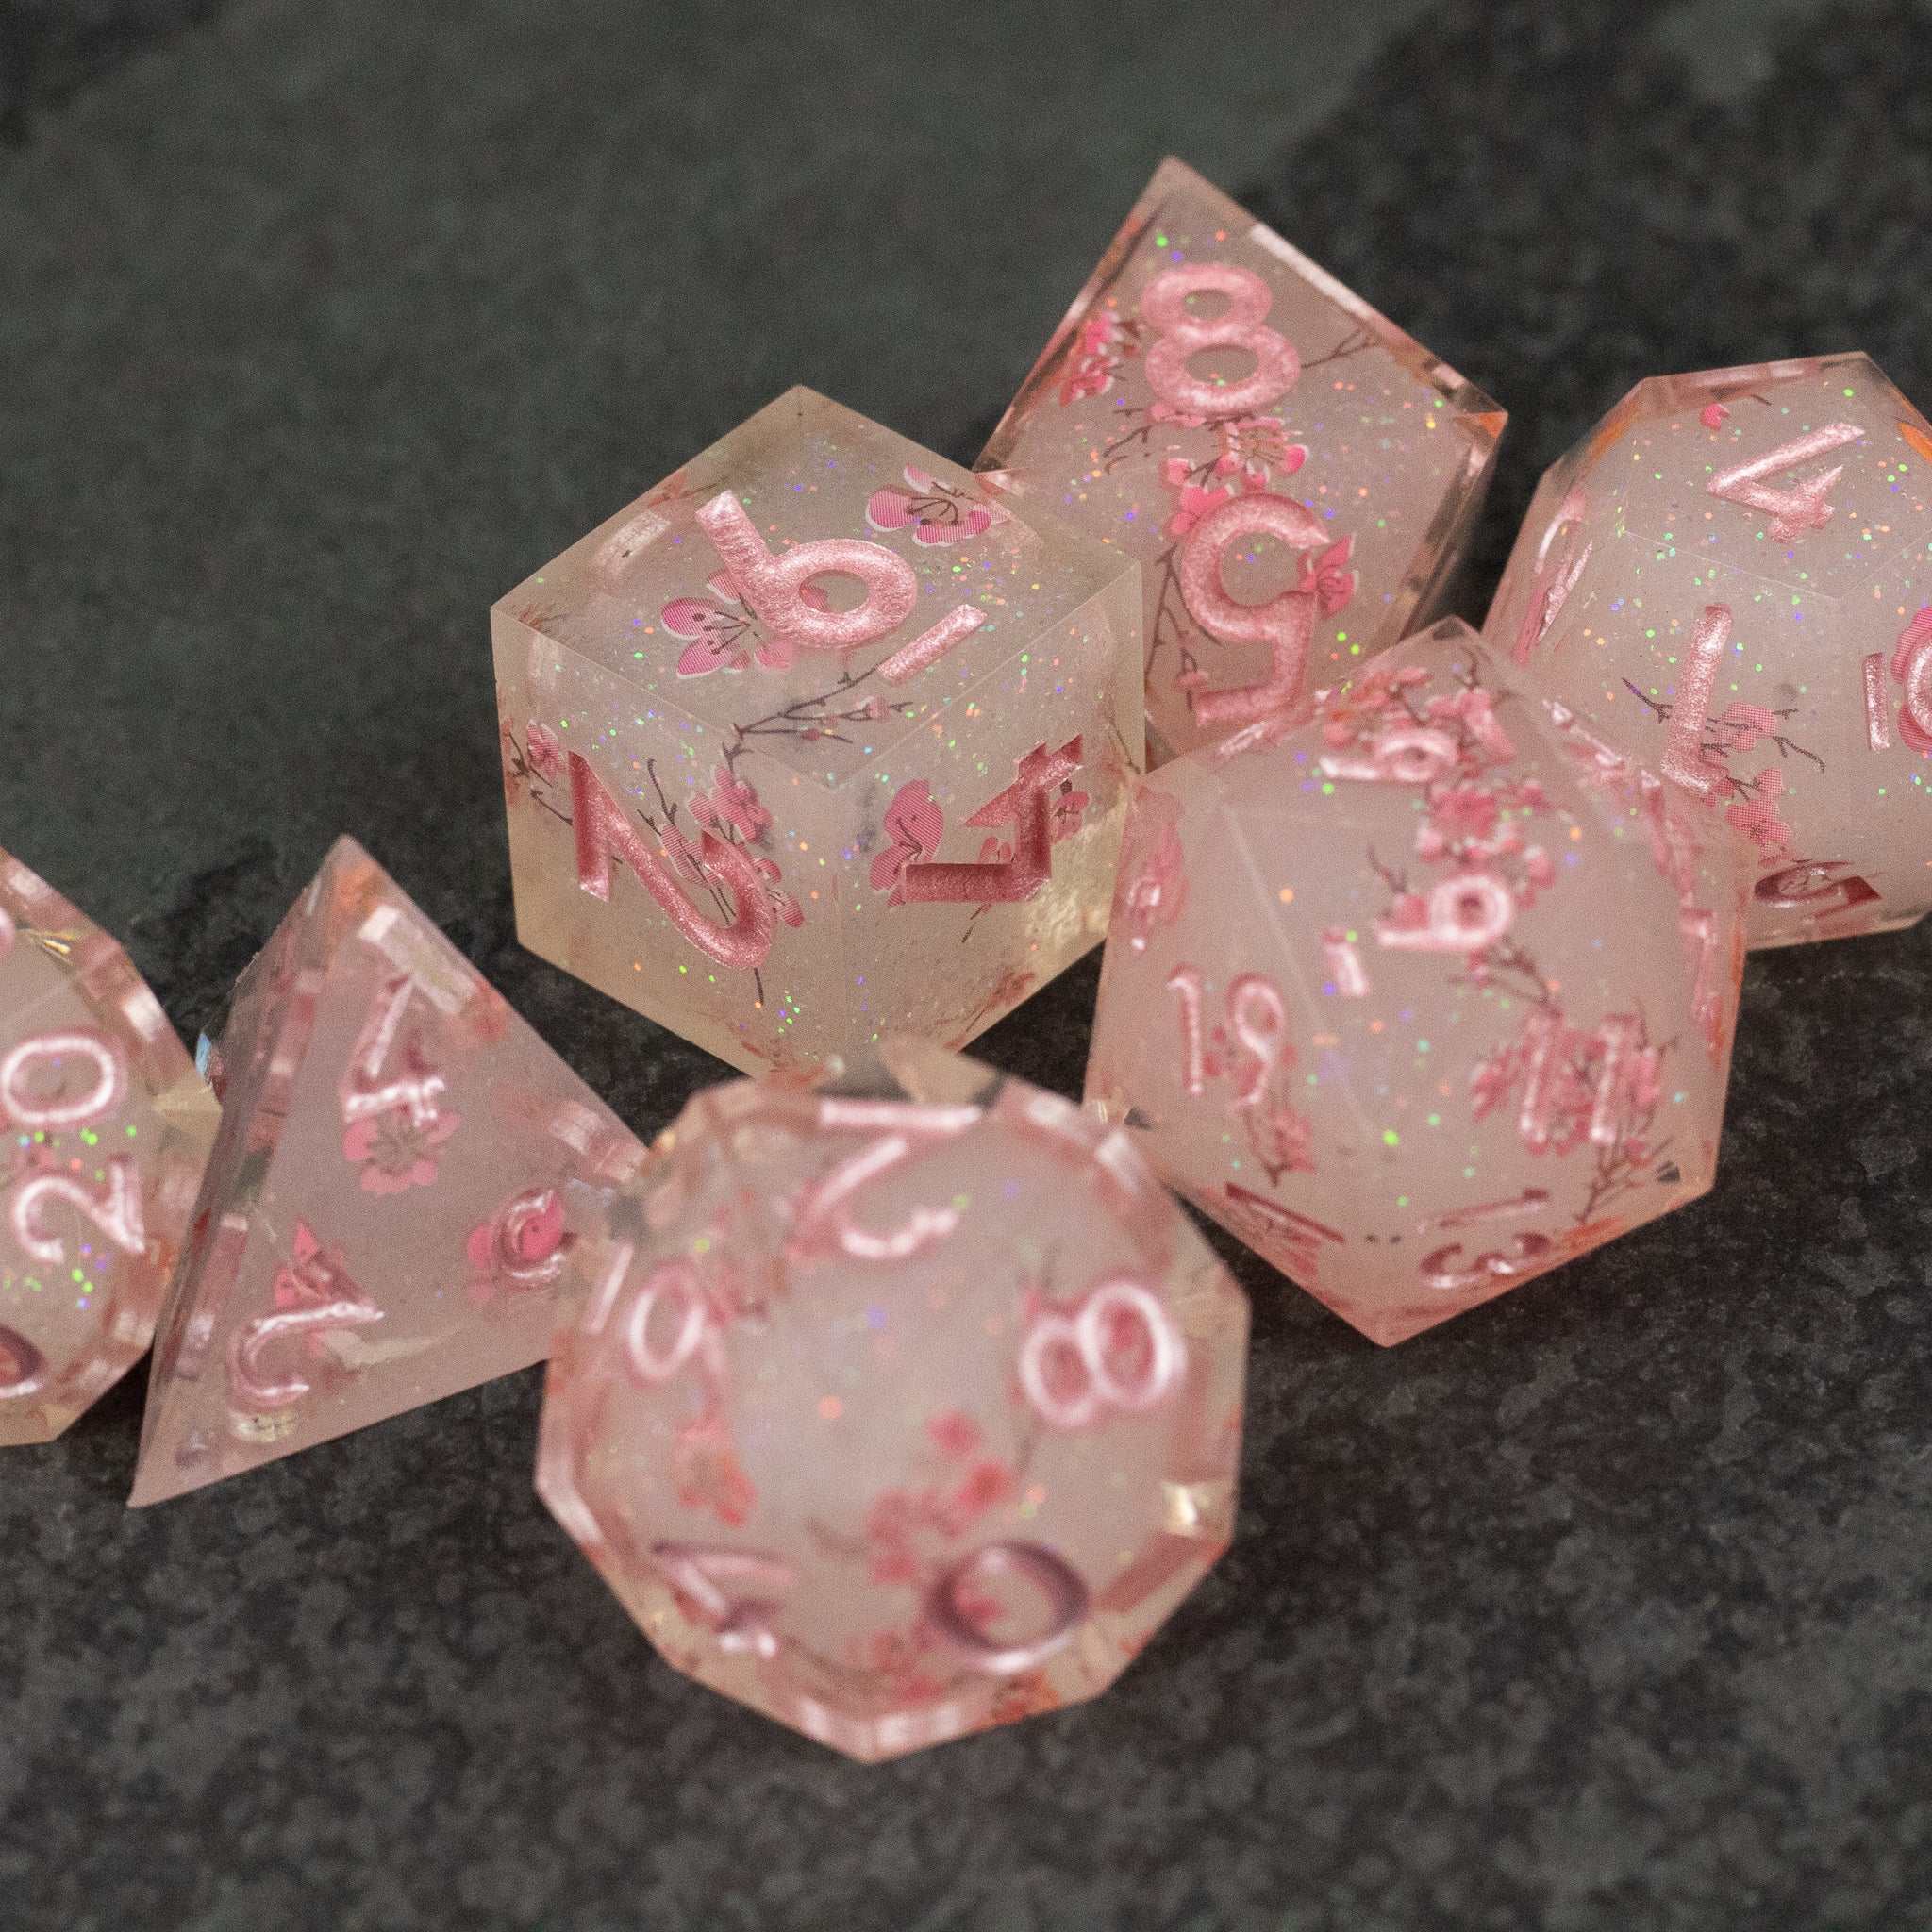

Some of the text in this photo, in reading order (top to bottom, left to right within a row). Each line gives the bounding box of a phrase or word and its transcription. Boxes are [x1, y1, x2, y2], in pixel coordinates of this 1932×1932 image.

[1140, 263, 1301, 417] 8
[1707, 421, 1866, 545] 4
[695, 490, 919, 648] 6
[1181, 493, 1331, 726] 5
[567, 750, 775, 970] 2
[1166, 960, 1290, 1111] 19
[1017, 1270, 1189, 1429] 8
